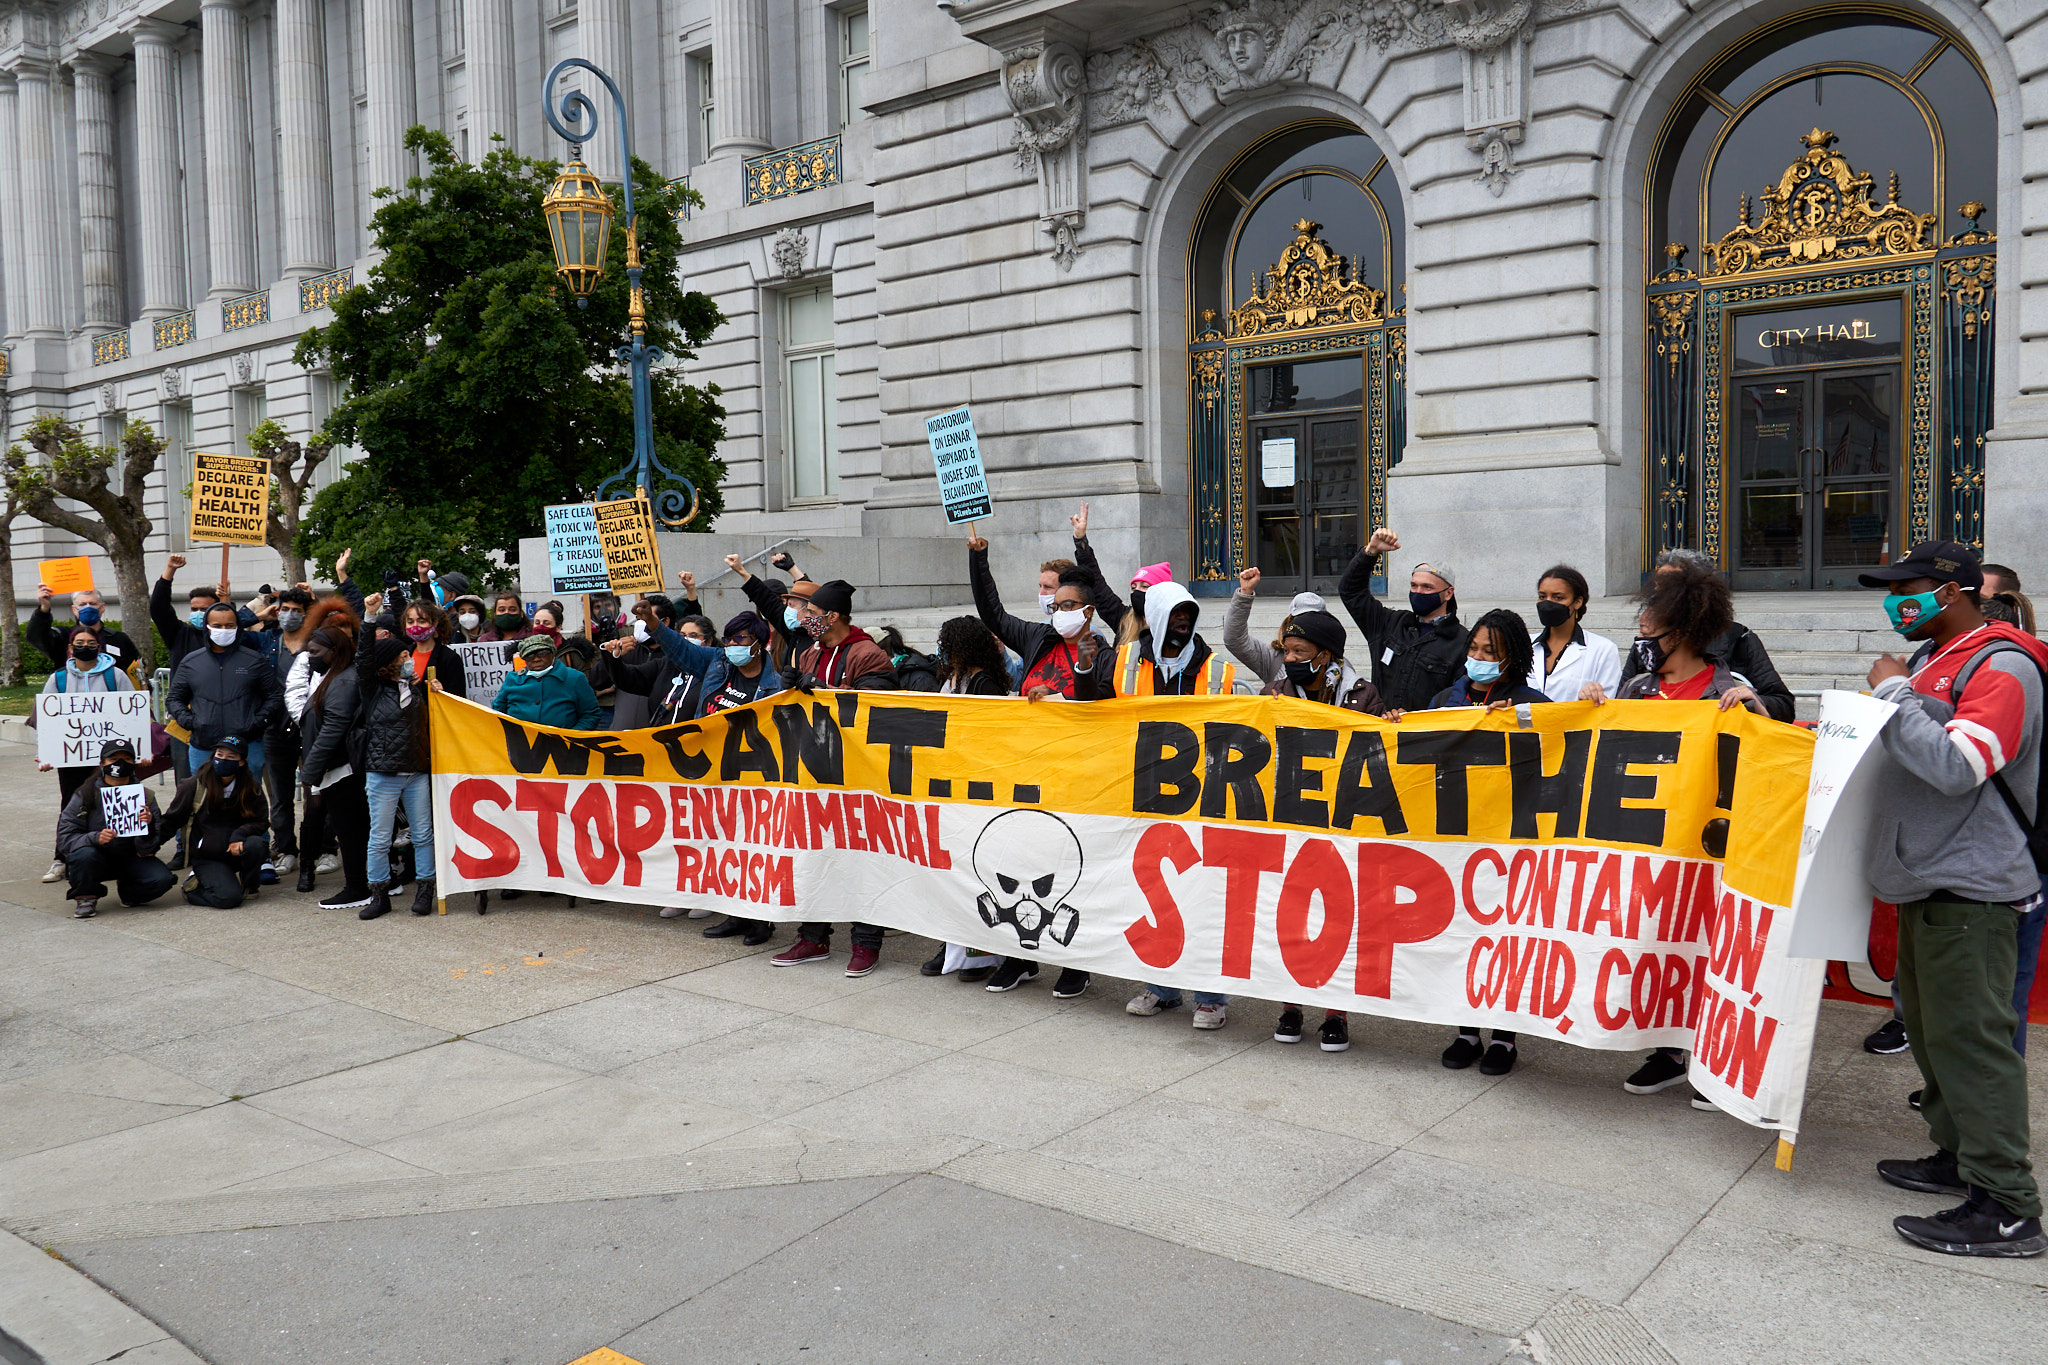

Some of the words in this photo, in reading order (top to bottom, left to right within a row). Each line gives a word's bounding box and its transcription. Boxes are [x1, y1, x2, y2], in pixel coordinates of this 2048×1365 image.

[1758, 328, 1810, 348] CITY
[1817, 321, 1877, 343] HALL
[927, 410, 970, 434] MORATORIUM
[934, 436, 944, 450] ON
[944, 430, 971, 447] LENNAR
[230, 459, 254, 467] BREED
[938, 448, 968, 467] SHIPYARD
[970, 447, 975, 459] &
[205, 463, 259, 473] SUPERVISORS:
[941, 468, 963, 485] UNSAFE
[965, 464, 980, 479] SOIL
[198, 470, 253, 486] DECLARE
[257, 476, 265, 487] A
[202, 485, 260, 500] PUBLIC
[943, 480, 984, 501] EXCAVATION!
[199, 498, 260, 515] HEALTH
[548, 509, 569, 520] SAFE
[597, 504, 615, 514] MAYOR
[615, 502, 631, 511] BREED
[194, 514, 263, 531] EMERGENCY
[556, 522, 582, 533] TOXIC
[599, 519, 635, 534] DECLARE
[637, 517, 642, 529] A
[193, 530, 262, 540] ANSWERCOALITION.ORG
[553, 537, 564, 548] AT
[566, 535, 600, 547] SHIPYA
[604, 532, 643, 549] PUBLIC
[557, 551, 564, 561] &
[607, 547, 647, 564] HEALTH
[567, 563, 602, 574] ISLAND!
[609, 563, 652, 580] EMERGENCY
[564, 581, 608, 590] PSLweb.org
[43, 695, 104, 717] CLEAN
[118, 693, 147, 716] UP
[65, 718, 124, 739] YOUR
[497, 716, 645, 776] WE
[102, 787, 122, 805] WE
[106, 794, 140, 819] CAN'T
[450, 778, 667, 888] STOP
[669, 785, 952, 870] ENVIRONMENTAL
[674, 845, 796, 906] RACISM
[1123, 822, 1456, 1000] STOP
[1466, 935, 1577, 1036] COVID,
